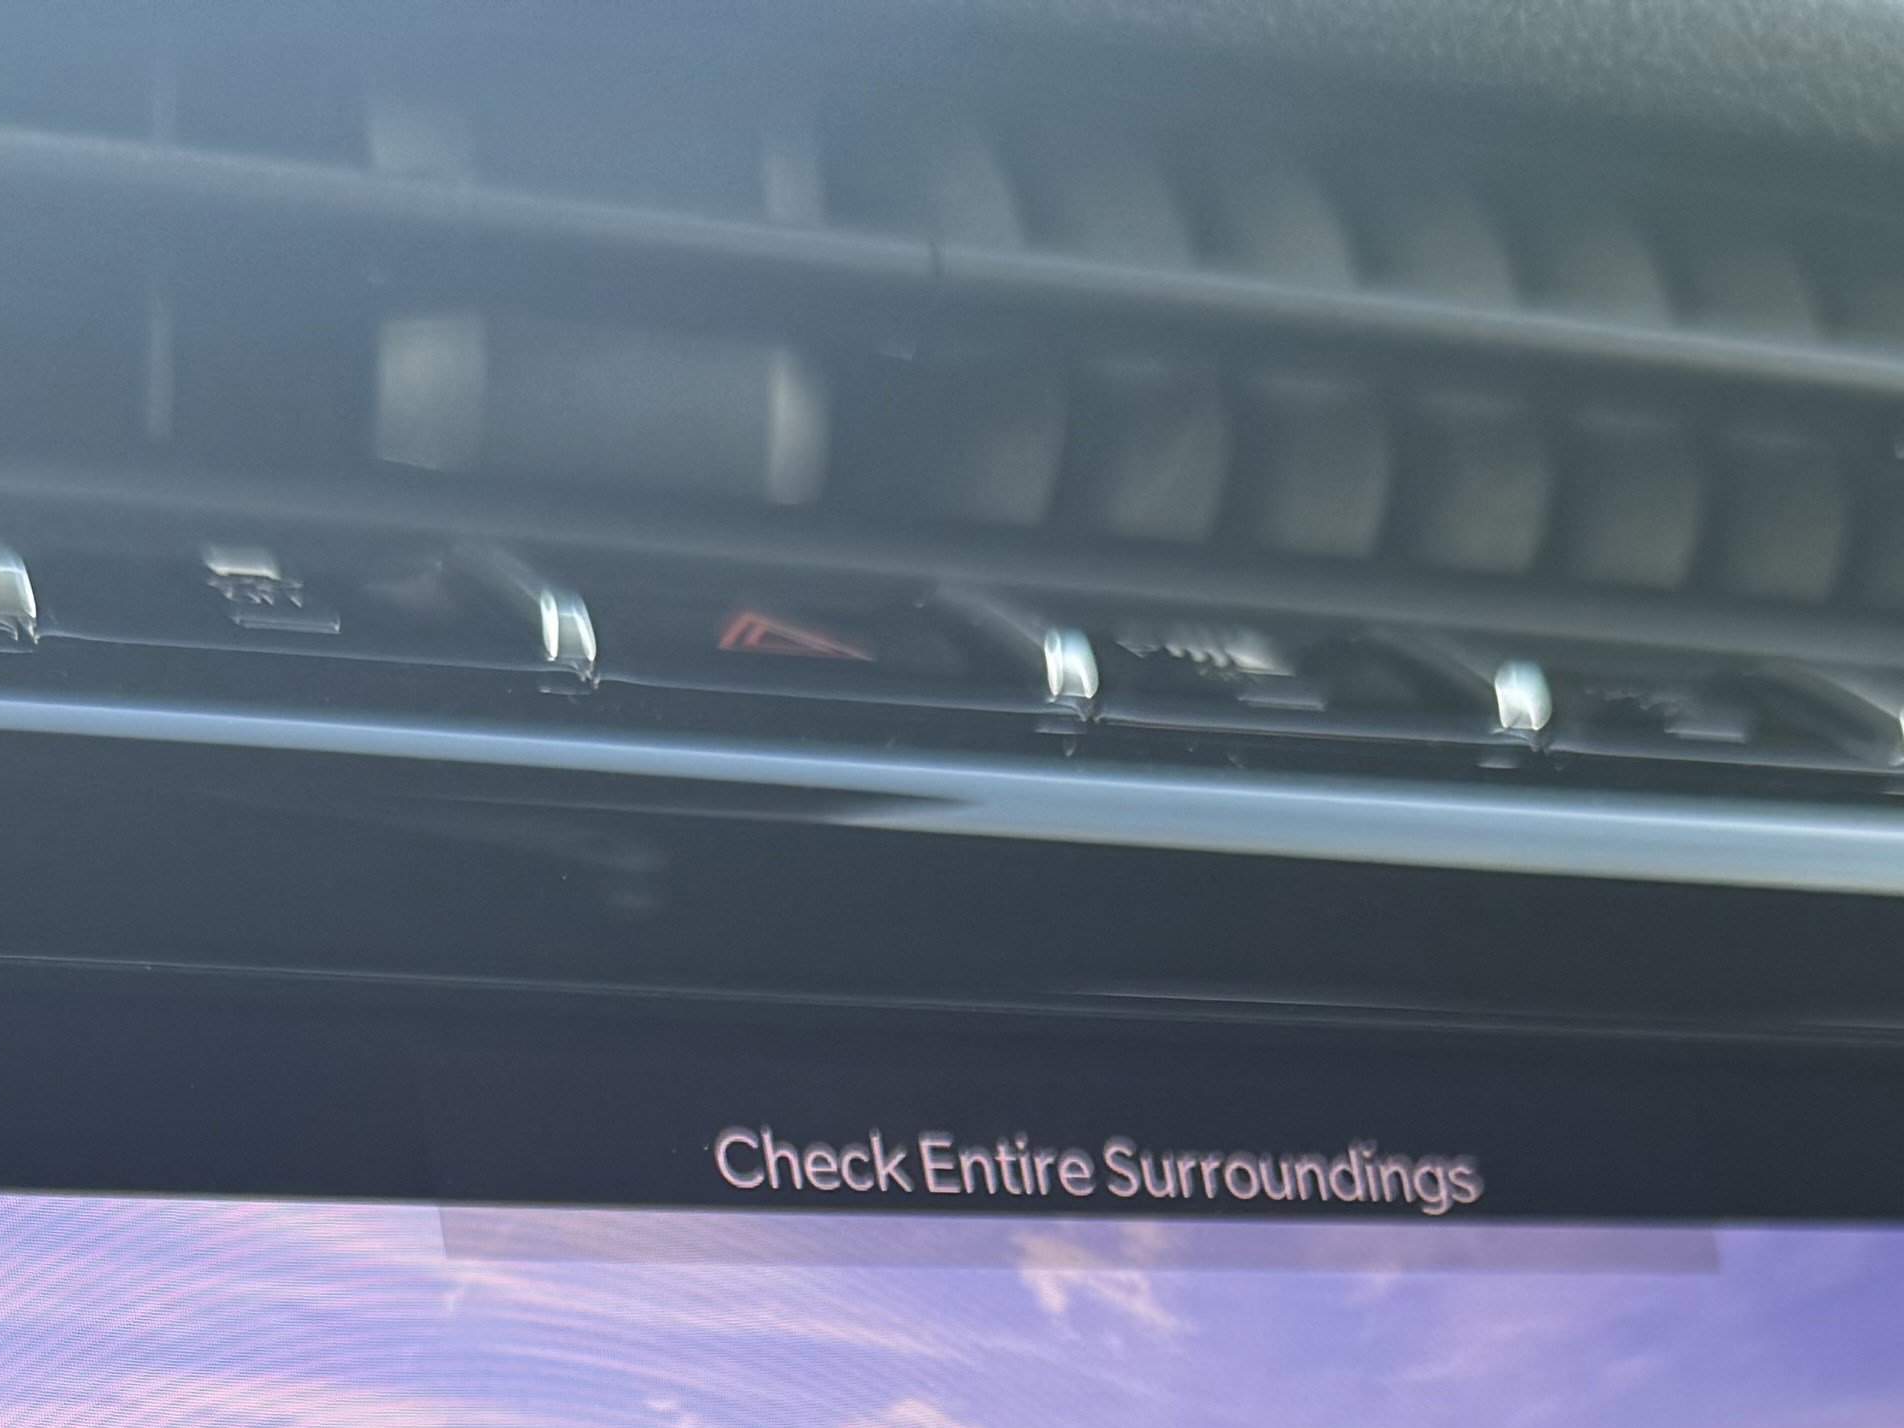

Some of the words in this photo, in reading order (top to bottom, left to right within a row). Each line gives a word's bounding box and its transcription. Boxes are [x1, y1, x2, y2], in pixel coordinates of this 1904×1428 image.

[714, 1126, 913, 1192] Check
[918, 1132, 1095, 1196] Entire
[1103, 1138, 1481, 1215] Surroundings
